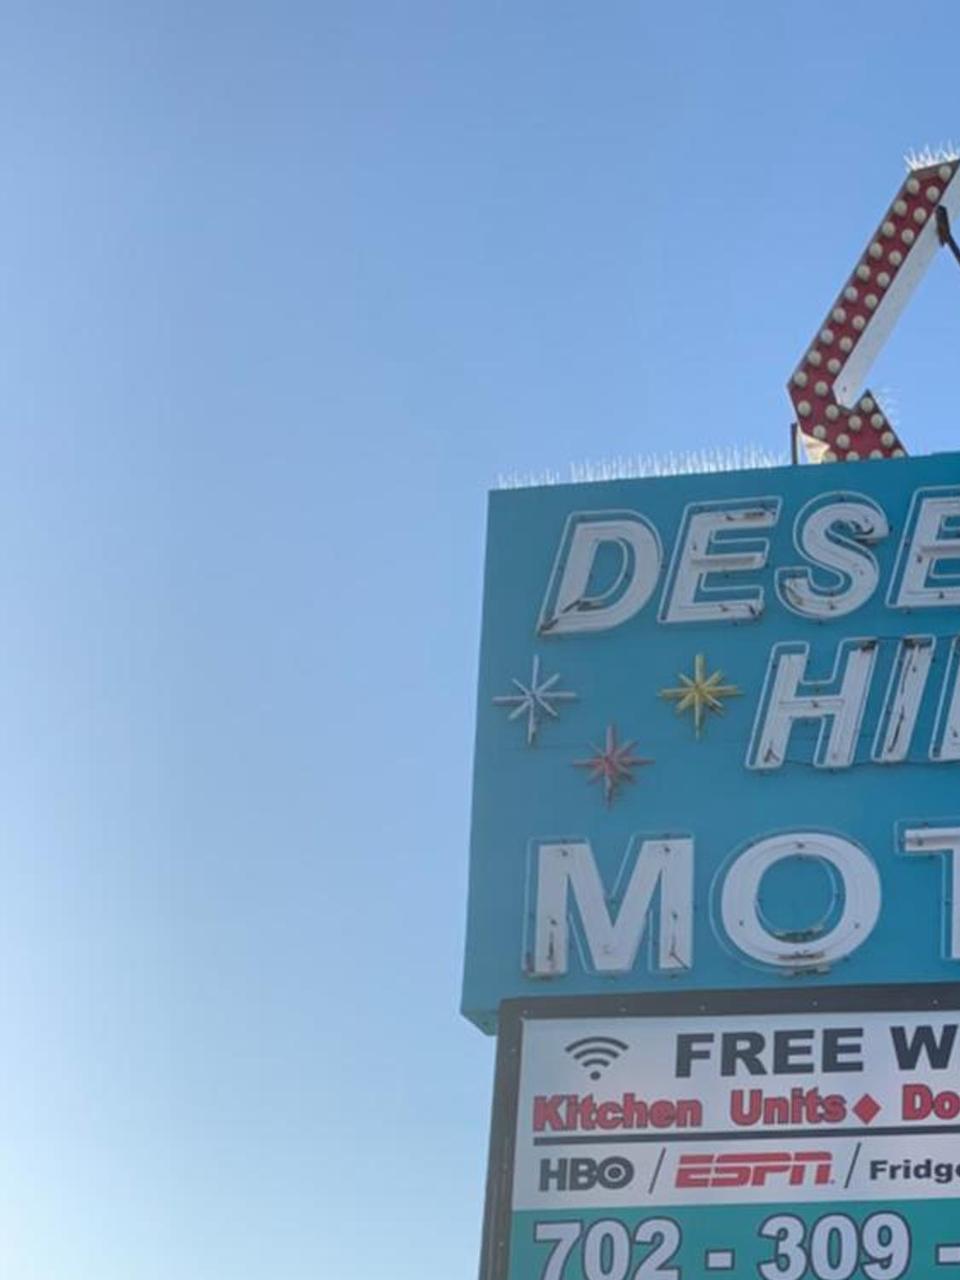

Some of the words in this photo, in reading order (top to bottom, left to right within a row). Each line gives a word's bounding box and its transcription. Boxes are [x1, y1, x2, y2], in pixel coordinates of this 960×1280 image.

[674, 1027, 865, 1078] FREE
[532, 1093, 703, 1132] Kitchen
[730, 1086, 847, 1127] Units
[538, 1156, 635, 1192] HBO
[675, 1151, 833, 1189] ESPN
